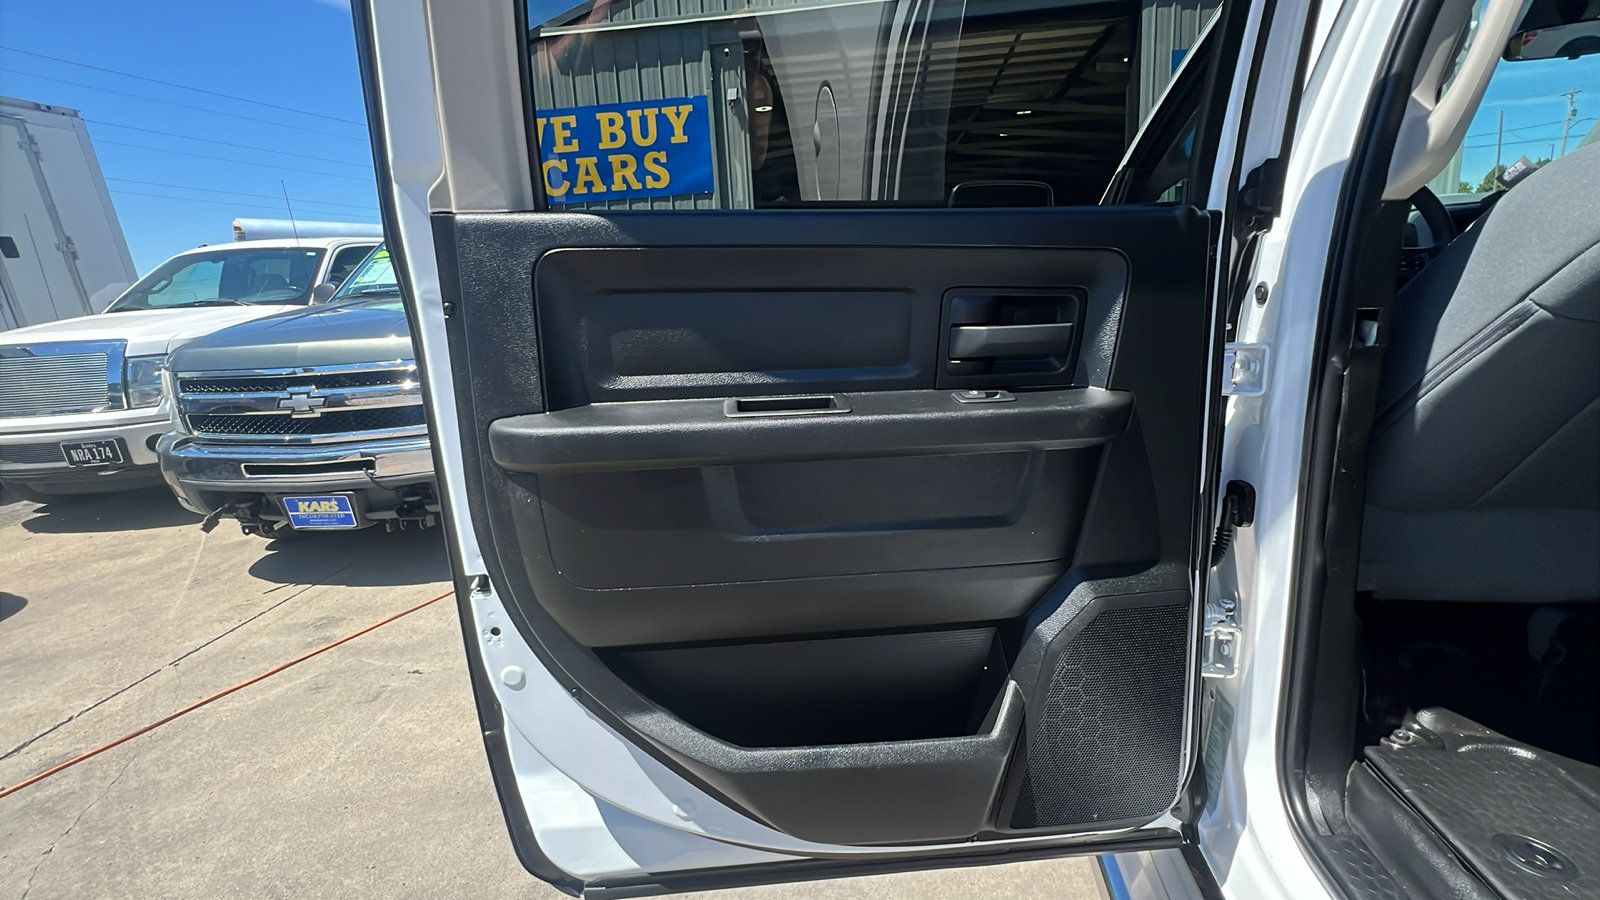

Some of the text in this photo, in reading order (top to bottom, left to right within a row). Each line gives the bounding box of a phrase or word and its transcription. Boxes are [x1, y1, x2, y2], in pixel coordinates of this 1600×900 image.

[595, 104, 693, 150] BUY
[542, 151, 670, 197] CARS
[70, 446, 113, 462] NRA 174
